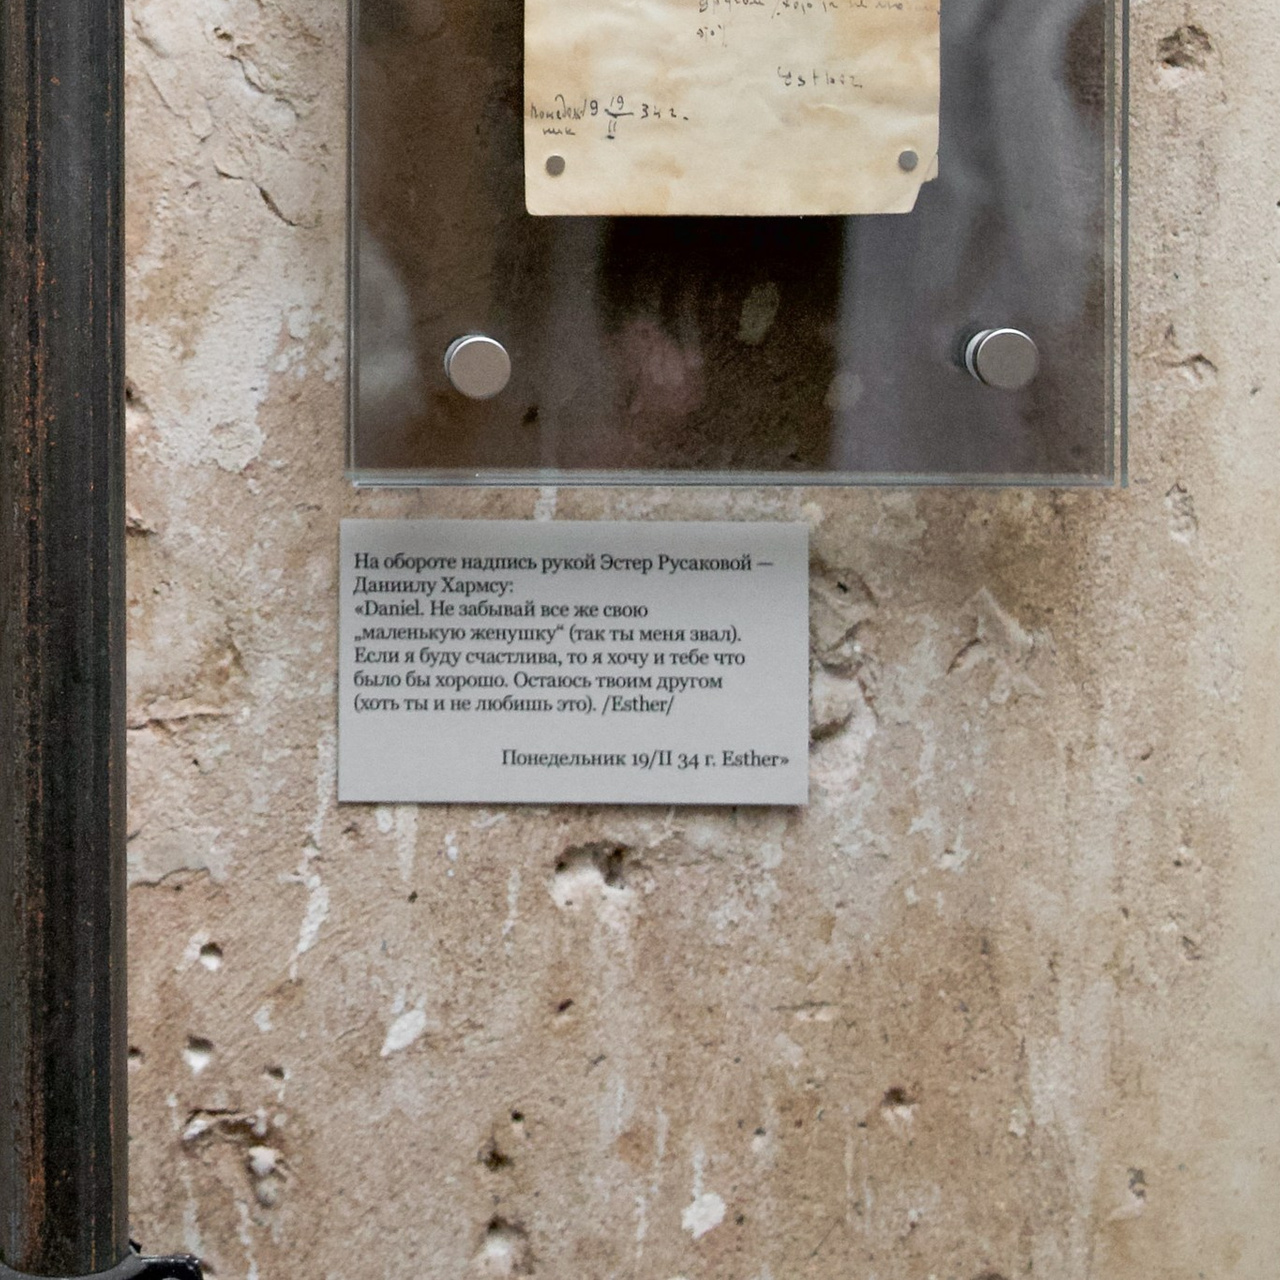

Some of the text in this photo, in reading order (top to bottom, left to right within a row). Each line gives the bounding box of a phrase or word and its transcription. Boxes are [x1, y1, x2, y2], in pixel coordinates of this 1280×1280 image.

[354, 552, 379, 569] На
[384, 552, 457, 573] обороте
[461, 557, 537, 571] надпись
[541, 553, 596, 575] рукой
[600, 553, 653, 575] Эстер
[658, 553, 751, 575] Русаковой
[353, 576, 513, 597] Даниилу Хармсу:
[355, 600, 648, 618] «Daniel. Не забывай все же свою
[354, 624, 741, 645] „маленькую женушку“ (так ты меня звал).
[355, 647, 745, 669] Если я буду счастлива, то я хочу и тебе что
[353, 670, 723, 693] было бы хорошо. Остаюсь твоим другом
[354, 693, 674, 716] (хоть ты и не любишь это). /Esther/
[502, 749, 789, 770] Понедельник 19/II 34 г. Esther»
